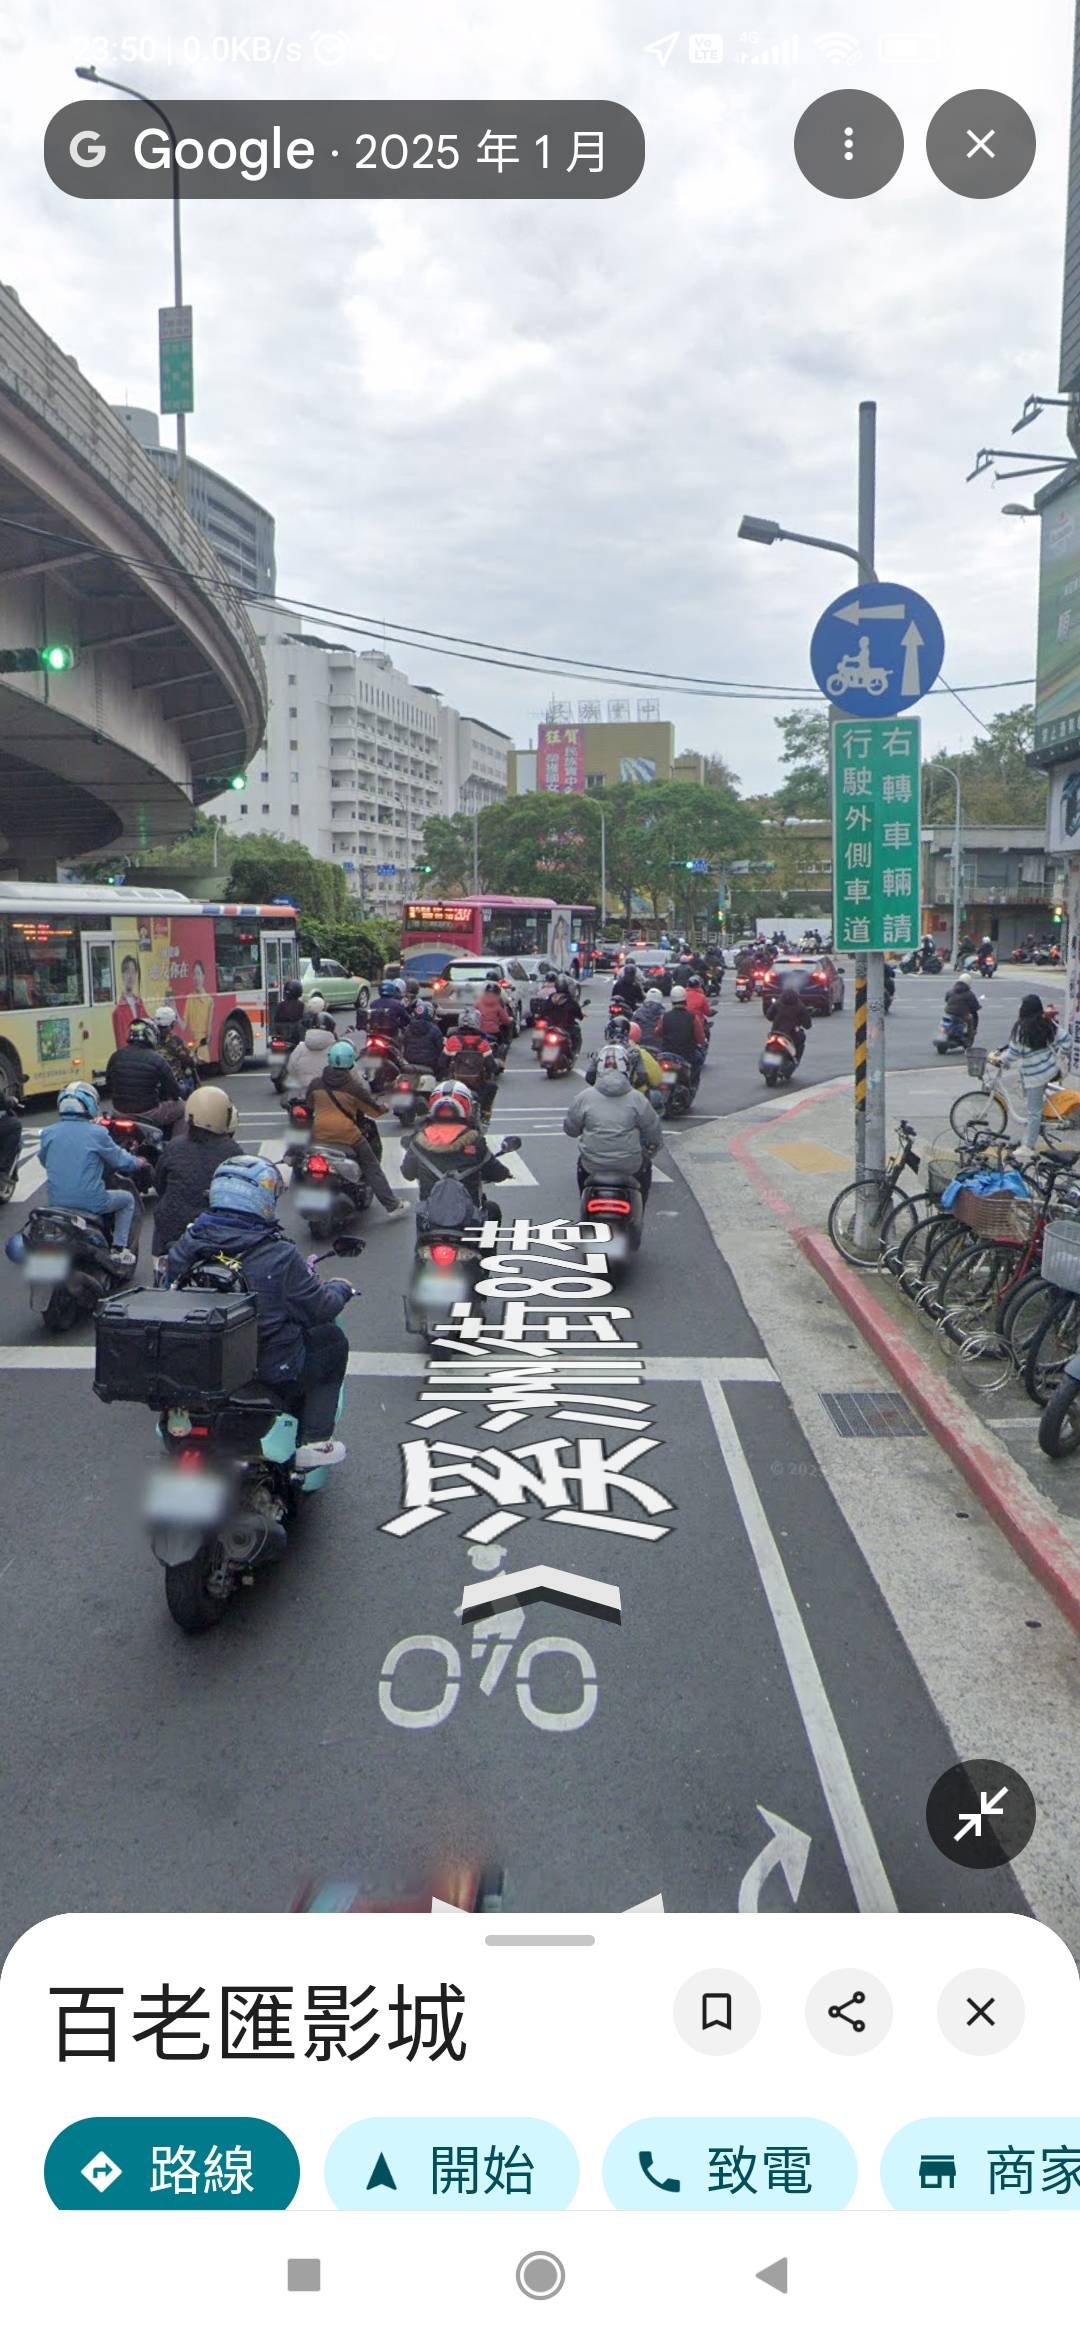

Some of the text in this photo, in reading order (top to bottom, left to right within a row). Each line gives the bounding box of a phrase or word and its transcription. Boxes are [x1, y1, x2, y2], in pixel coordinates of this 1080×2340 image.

[842, 728, 873, 944] 行駛外側車道
[881, 726, 913, 944] 右轉車輛請
